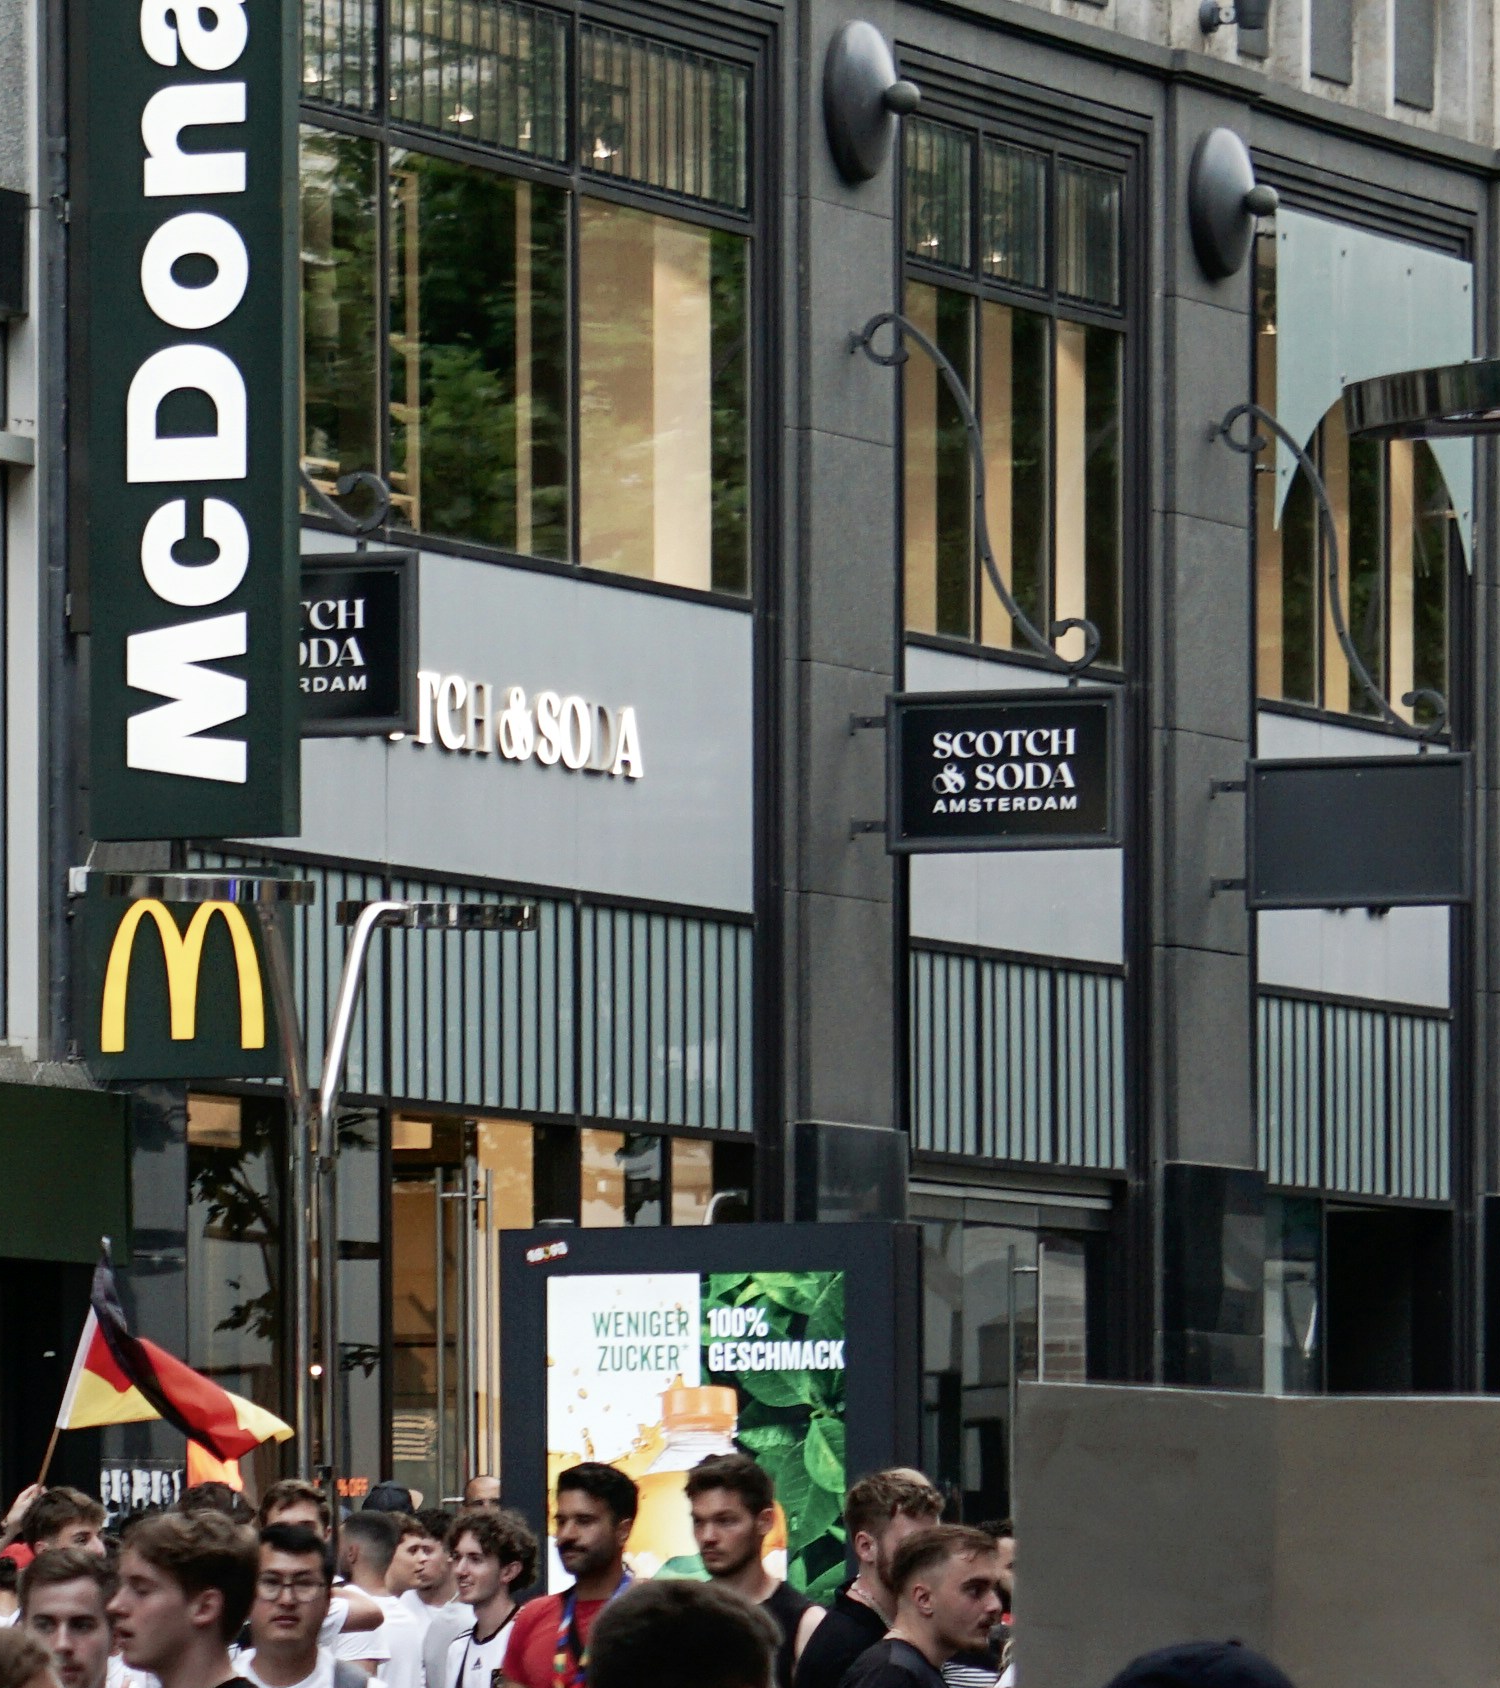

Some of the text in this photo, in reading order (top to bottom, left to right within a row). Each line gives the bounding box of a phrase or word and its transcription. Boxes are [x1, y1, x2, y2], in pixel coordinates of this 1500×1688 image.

[536, 690, 644, 779] SODA
[931, 728, 1076, 759] SCOTCH
[931, 761, 1076, 795] & SODA
[931, 795, 1078, 814] AMSTERDAM
[592, 1309, 690, 1339] WENIGER
[706, 1306, 770, 1339] 100%
[707, 1339, 846, 1373] GESCHMACK
